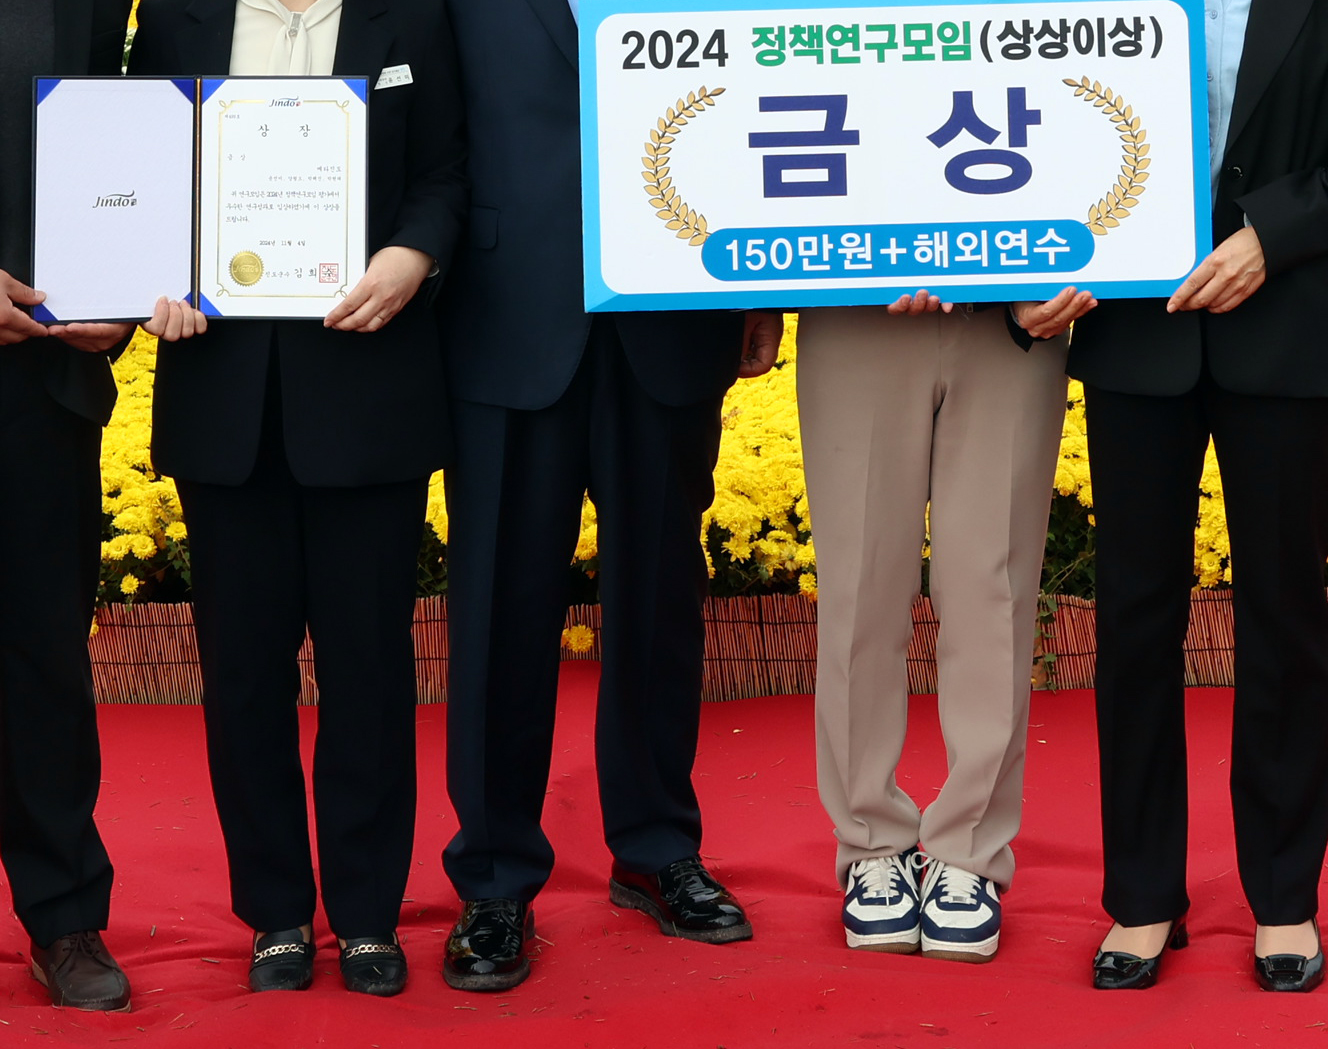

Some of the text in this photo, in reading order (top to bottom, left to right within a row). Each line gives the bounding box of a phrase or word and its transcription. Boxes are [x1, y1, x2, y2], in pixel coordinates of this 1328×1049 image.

[621, 28, 729, 70] 2024
[269, 97, 297, 107] Jindo
[92, 193, 132, 208] Jindo
